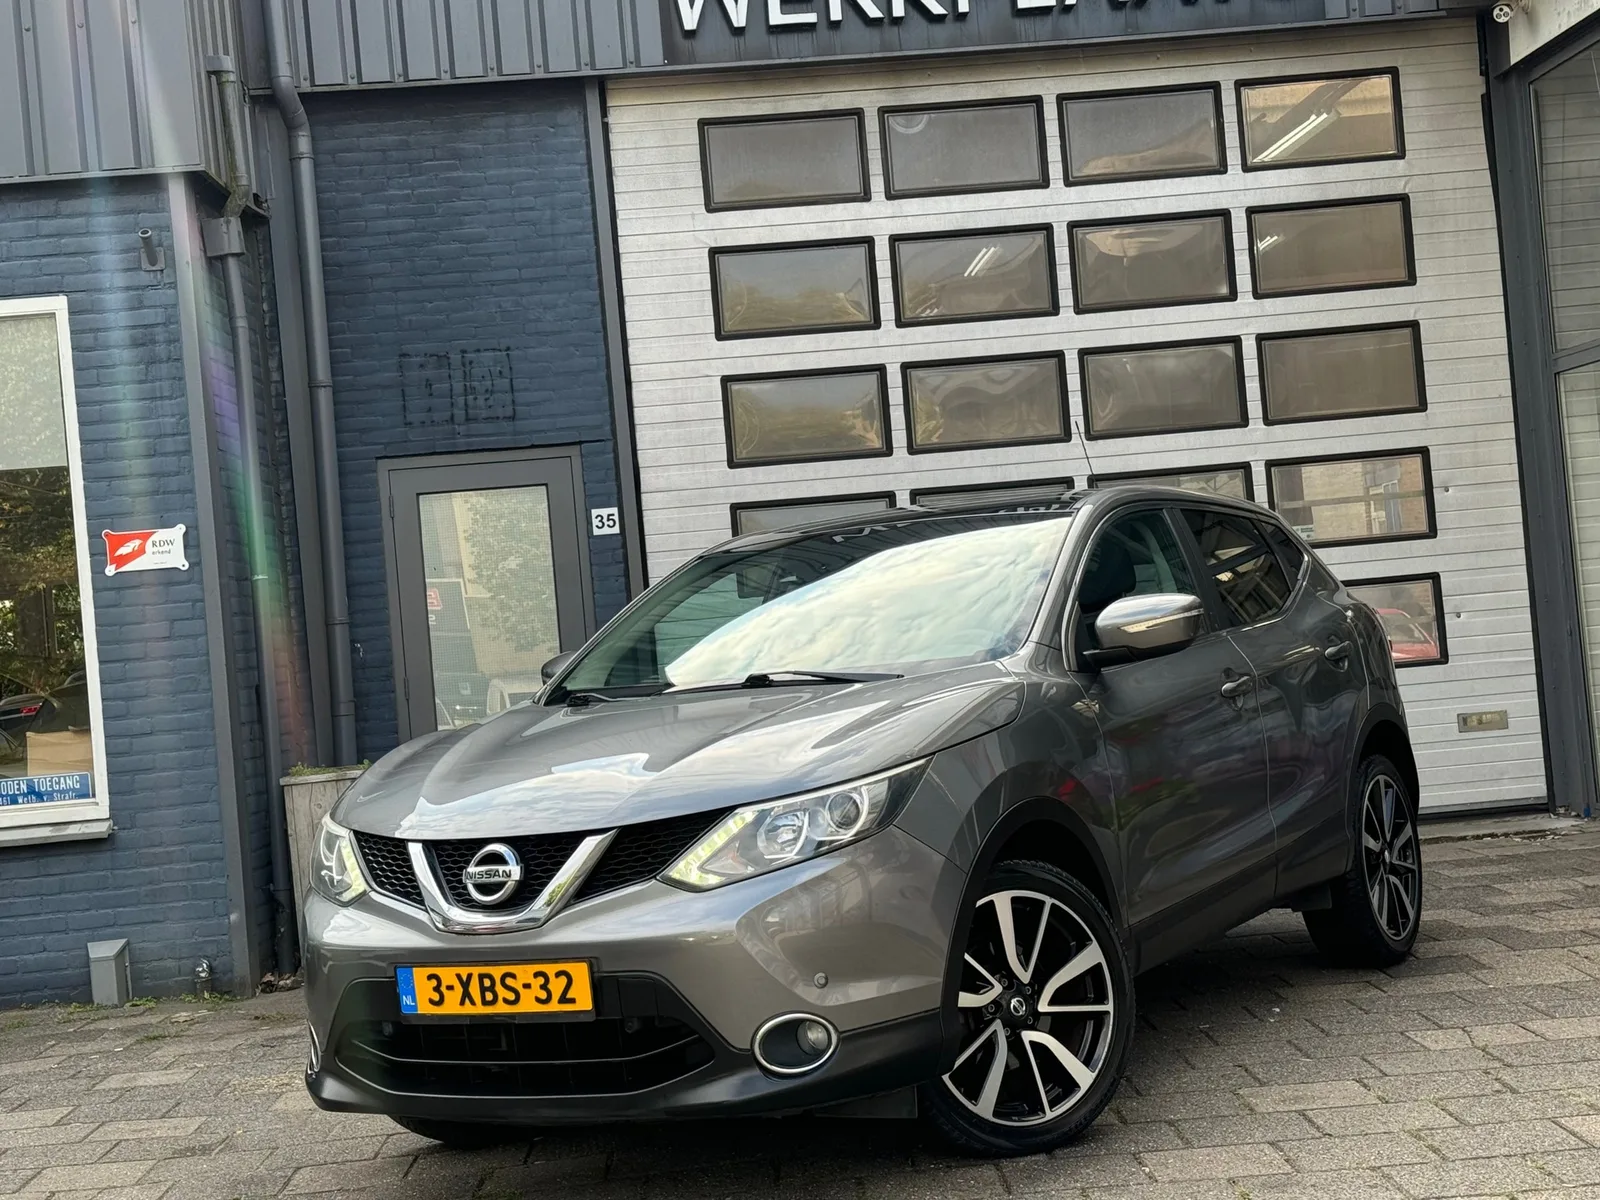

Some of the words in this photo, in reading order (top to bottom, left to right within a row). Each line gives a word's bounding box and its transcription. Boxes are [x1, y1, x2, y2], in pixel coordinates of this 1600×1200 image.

[595, 513, 616, 529] 35
[151, 538, 175, 548] RDW
[33, 775, 80, 792] TOEGANG
[466, 869, 512, 880] NISSAN
[426, 969, 577, 1007] 3-XBS-32
[402, 994, 416, 1006] NL
